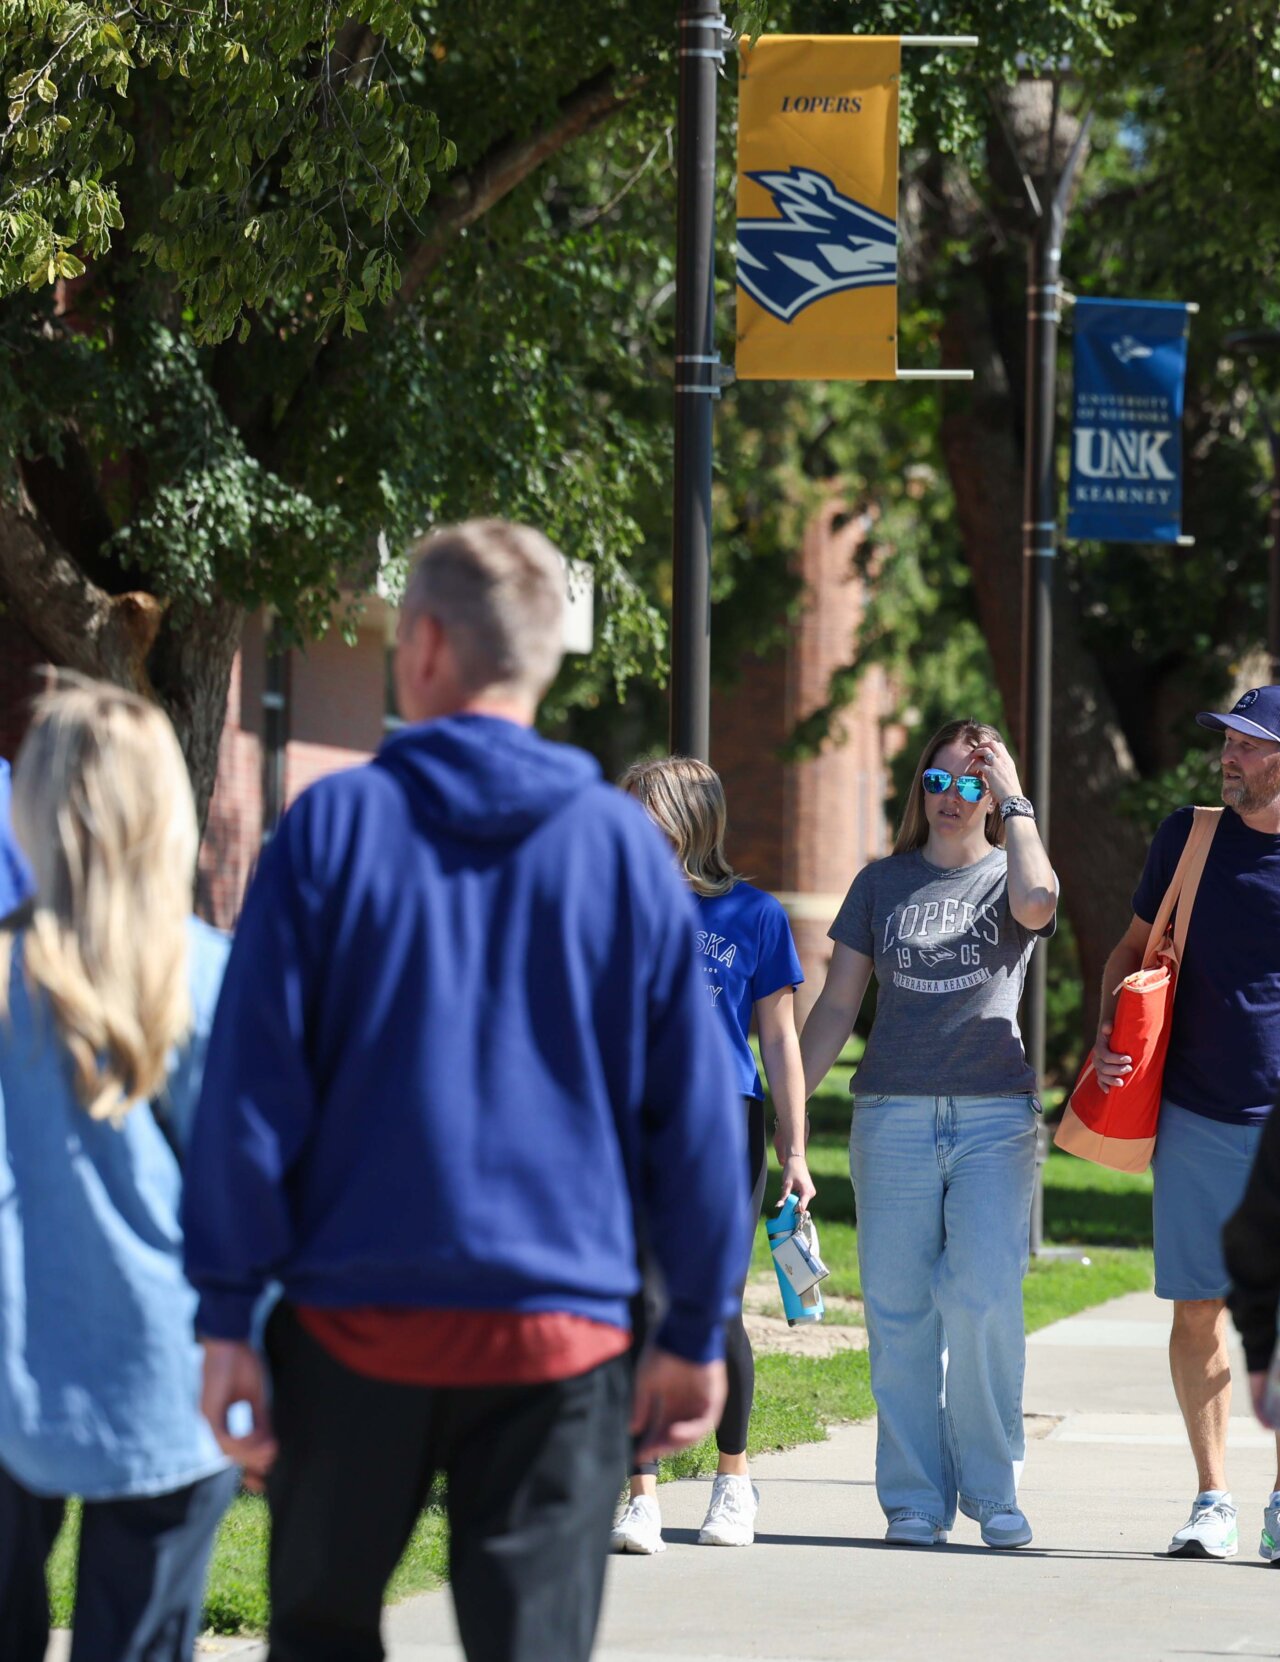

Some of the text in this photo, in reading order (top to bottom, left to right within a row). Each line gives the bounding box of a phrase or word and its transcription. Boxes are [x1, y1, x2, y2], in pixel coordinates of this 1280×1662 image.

[780, 95, 863, 113] LOPERS
[1073, 427, 1175, 480] UNK
[1076, 485, 1171, 505] KEARNEY
[882, 898, 999, 954] LOPERS
[896, 944, 981, 969] 19 05
[943, 970, 985, 991] KEARNEY
